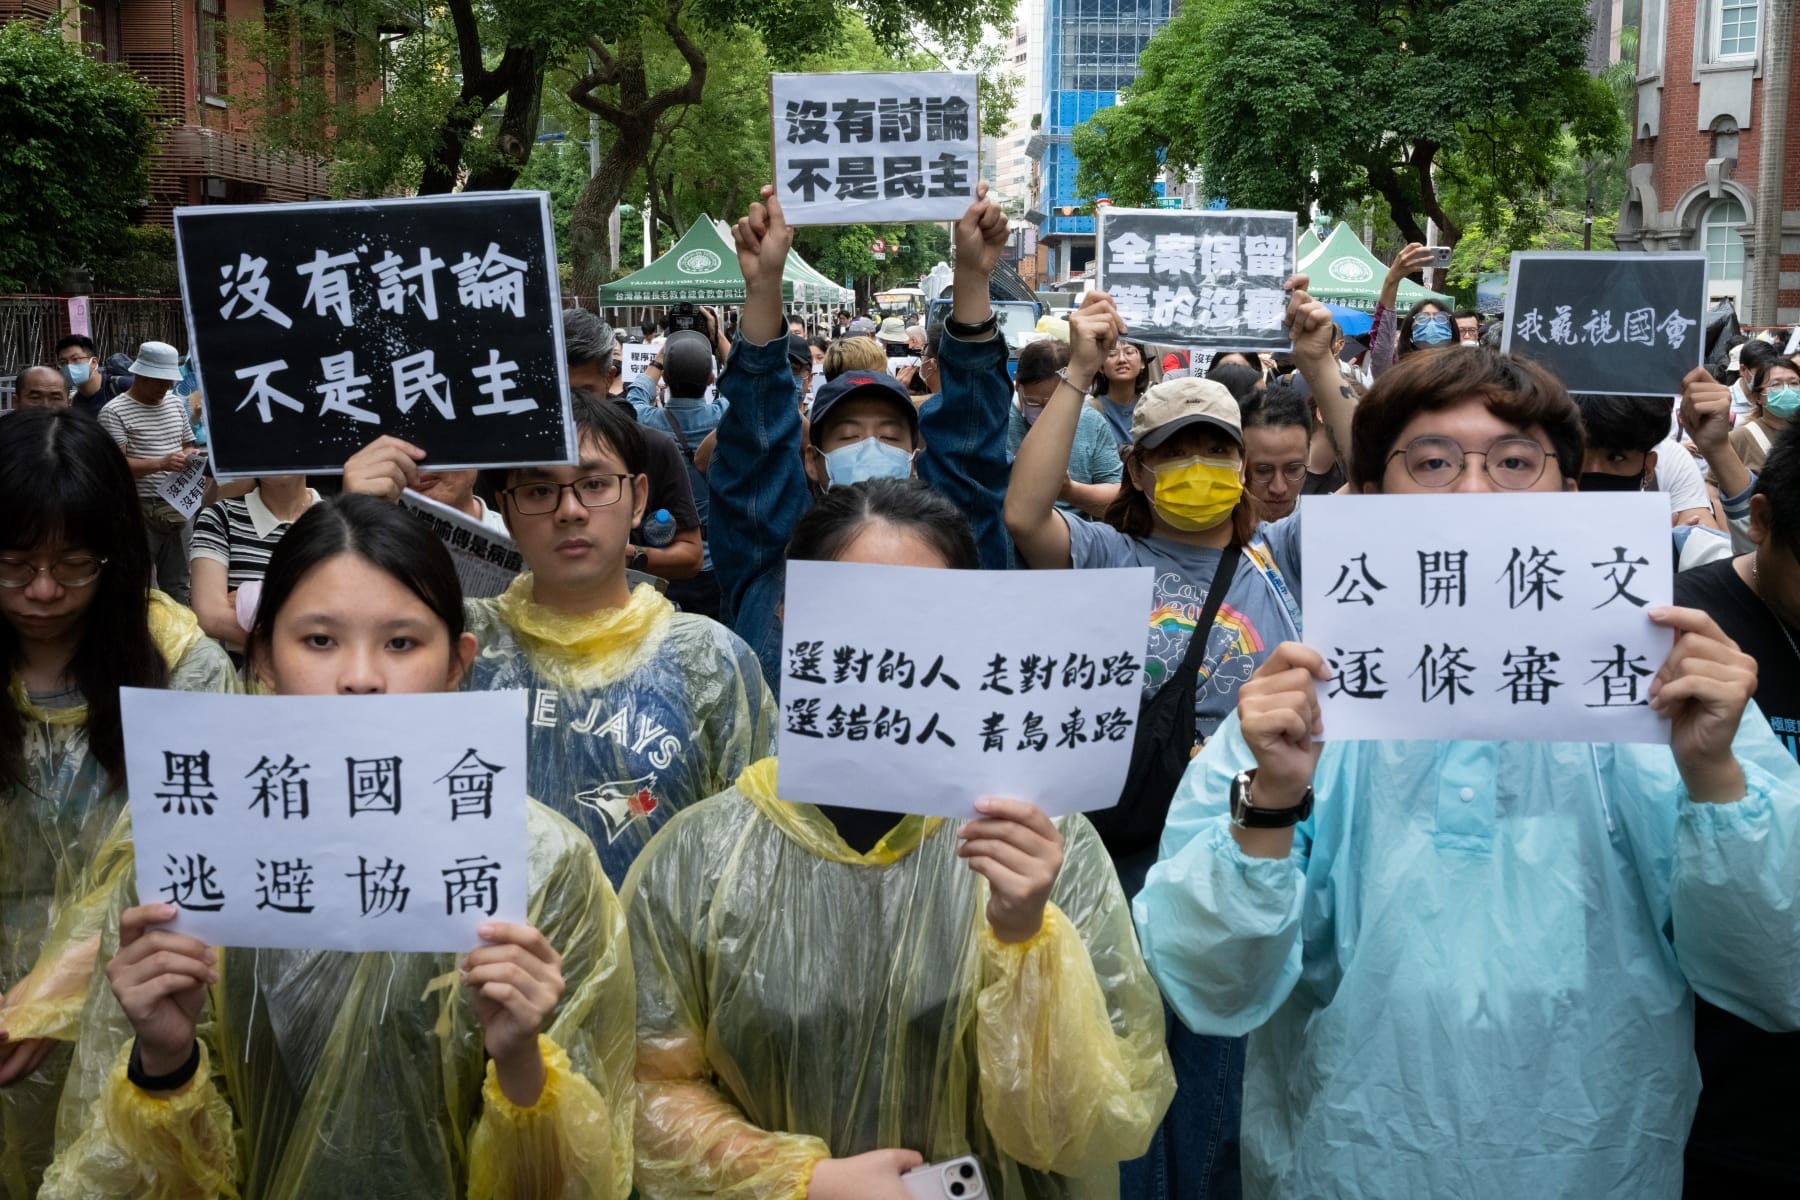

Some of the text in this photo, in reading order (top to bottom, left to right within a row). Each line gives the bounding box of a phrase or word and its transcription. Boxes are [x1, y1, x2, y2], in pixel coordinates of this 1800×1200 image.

[785, 96, 969, 144] 沒有討論
[787, 152, 970, 202] 不是民主
[1108, 232, 1287, 277] 全案保留
[219, 242, 528, 329] 沒有討論
[1108, 285, 1287, 331] 等於沒審
[1516, 305, 1697, 350] 我藐視國會
[235, 349, 539, 424] 不是民主
[1324, 545, 1650, 611] 公開條文
[787, 641, 1141, 695] 選對的人 走對的路
[1326, 642, 1655, 707] 逐條審查
[571, 699, 682, 769] JAYS
[785, 698, 1135, 753] 選錯的人 青島東路
[154, 748, 507, 822] 黑箱國會
[159, 853, 503, 919] 逃避協商
